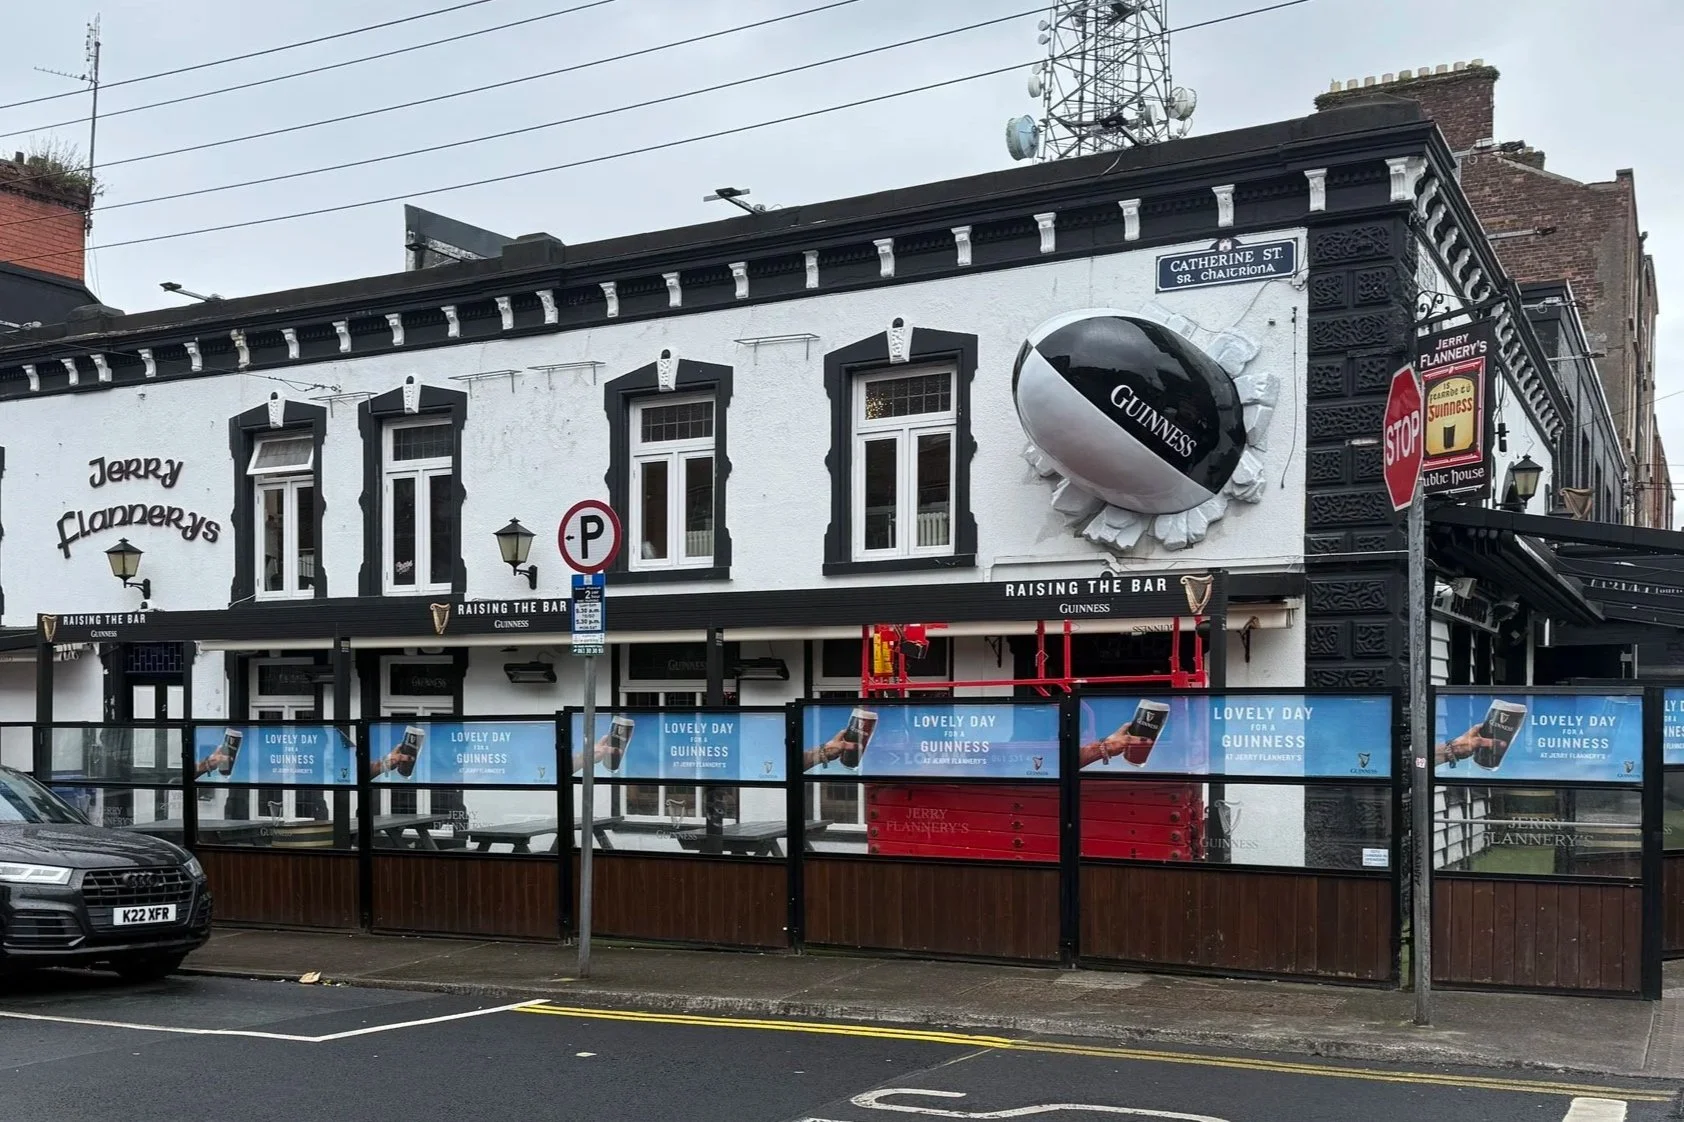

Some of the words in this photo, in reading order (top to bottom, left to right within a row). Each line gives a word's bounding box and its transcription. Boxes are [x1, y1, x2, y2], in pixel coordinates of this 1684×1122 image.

[1170, 250, 1254, 272] CATHERINE
[1262, 247, 1284, 260] ST.
[1176, 274, 1195, 284] SR.
[1435, 333, 1469, 350] JERRY
[1420, 340, 1488, 368] FLANNERY'S
[1428, 397, 1473, 422] Guinness
[1110, 384, 1197, 458] GUINNESS
[1386, 410, 1420, 466] STOP
[1450, 467, 1485, 485] house
[580, 514, 604, 560] P
[1005, 580, 1079, 597] RAISING
[1088, 579, 1121, 594] THE
[1131, 578, 1167, 593] BAR
[584, 590, 591, 599] 2
[457, 602, 508, 615] RAISING
[514, 602, 537, 613] THE
[543, 601, 567, 613] BAR
[1059, 602, 1110, 614] GUINNESS
[63, 615, 101, 626] RAISING
[105, 614, 124, 625] THE
[127, 614, 146, 624] BAR
[494, 619, 529, 629] GUINNESS
[90, 629, 118, 639] GUINNESS
[1213, 707, 1274, 720] LOVELY
[1282, 706, 1314, 720] DAY
[913, 715, 964, 728] LOVELY
[970, 715, 996, 728] DAY
[1251, 723, 1266, 731] FOR
[1531, 715, 1584, 726] LOVELY
[1589, 716, 1616, 727] DAY
[664, 723, 707, 734] LOVELY
[712, 723, 734, 734] DAY
[265, 734, 298, 744] LOVELY
[301, 734, 318, 744] DAY
[451, 732, 489, 742] LOVELY
[492, 732, 512, 742] DAY
[1222, 734, 1306, 749] GUINNESS
[1537, 737, 1609, 749] GUINNESS
[670, 745, 728, 757] GUINNESS
[920, 740, 990, 752] GUINNESS
[270, 754, 314, 764] GUINNESS
[456, 753, 507, 764] GUINNESS
[1259, 753, 1302, 761] FLANNERY'S
[906, 808, 948, 819] JERRY
[886, 820, 969, 834] FLANNERY'S
[1507, 816, 1566, 831] JERRY
[655, 829, 698, 840] GUINNESS
[1483, 832, 1594, 847] FLANNERY'S
[1199, 838, 1259, 850] GUINNESS
[122, 908, 146, 923] K22
[147, 907, 169, 922] XFR
